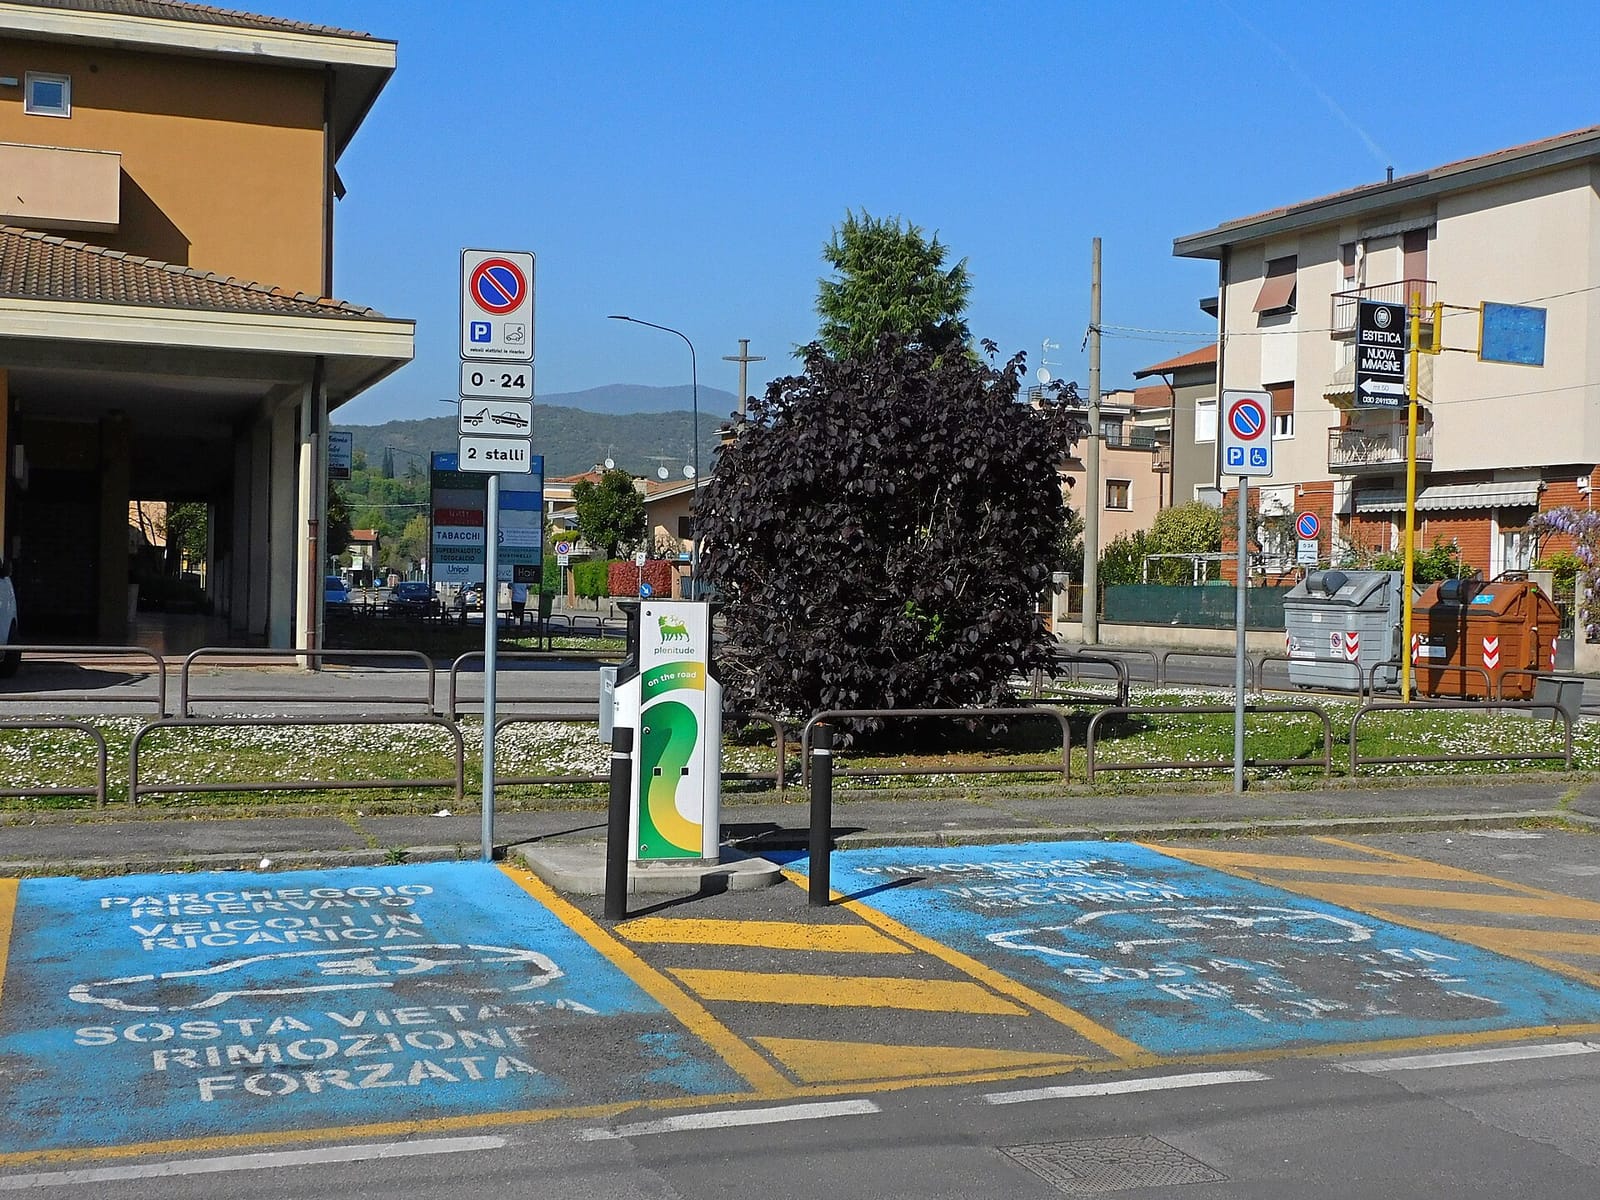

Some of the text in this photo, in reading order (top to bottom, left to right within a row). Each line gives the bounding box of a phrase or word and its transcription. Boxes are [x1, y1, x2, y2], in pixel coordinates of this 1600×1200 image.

[1362, 329, 1402, 344] ESTETICA
[1367, 347, 1396, 361] NUOVA
[1361, 358, 1401, 372] IMMAGINE
[471, 372, 484, 387] 0
[501, 373, 526, 389] 24
[1362, 396, 1374, 404] 030
[467, 447, 525, 461] 2 stalli
[436, 531, 481, 541] TABACCHI
[447, 564, 470, 575] Unipol
[518, 567, 536, 577] Hair
[654, 647, 695, 656] plenitude
[648, 678, 659, 687] on
[660, 673, 675, 682] the
[100, 884, 433, 909] PARCHEGGIO
[131, 895, 415, 918] RISERVATO
[130, 912, 425, 938] VEICOLI IN
[142, 925, 424, 951] RICARICA
[74, 1015, 313, 1046] SOSTA
[197, 1056, 545, 1102] FORZATA
